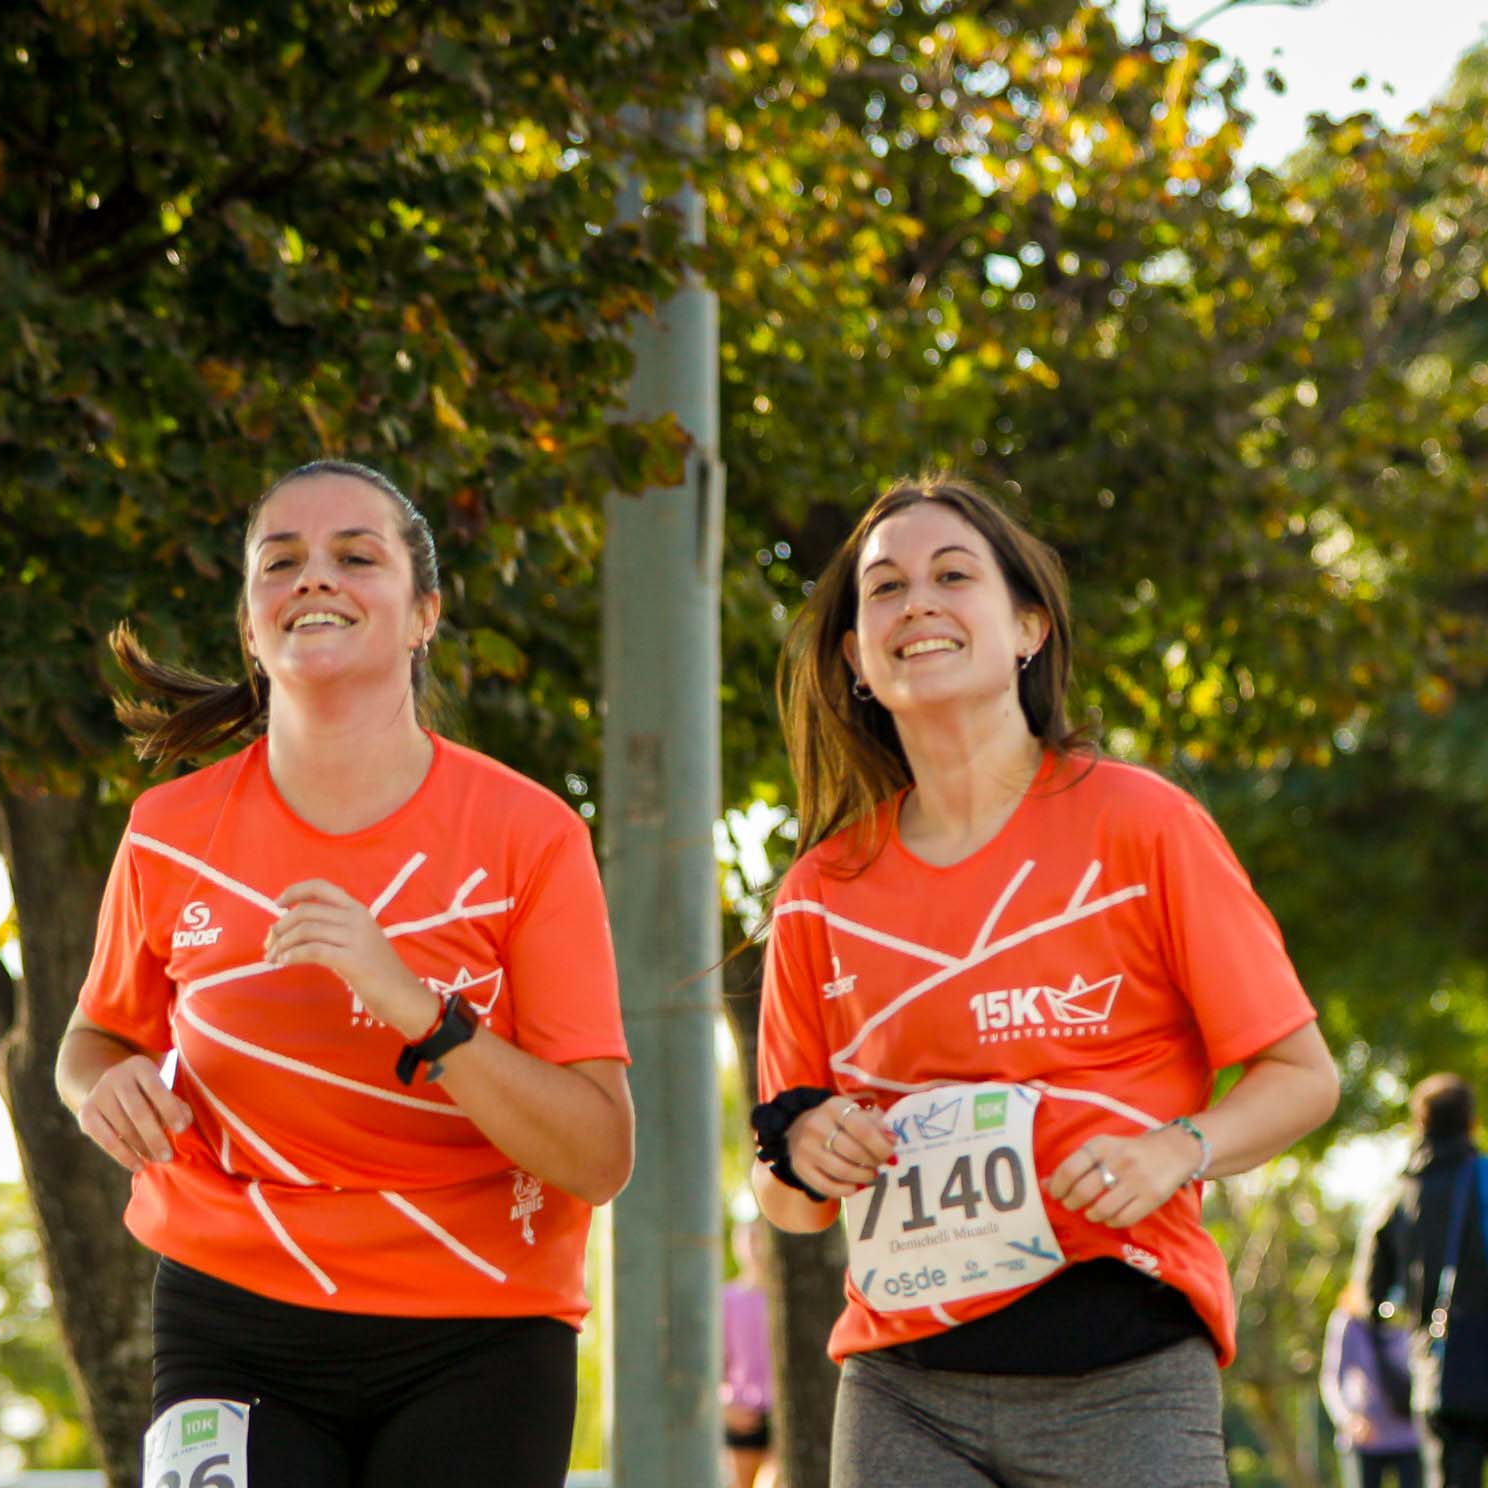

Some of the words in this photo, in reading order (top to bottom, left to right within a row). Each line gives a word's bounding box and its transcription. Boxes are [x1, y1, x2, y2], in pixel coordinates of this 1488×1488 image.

[969, 986, 1044, 1031] 15K
[859, 1146, 1027, 1241] 7140
[884, 1266, 947, 1296] osde
[184, 1416, 214, 1436] 10K
